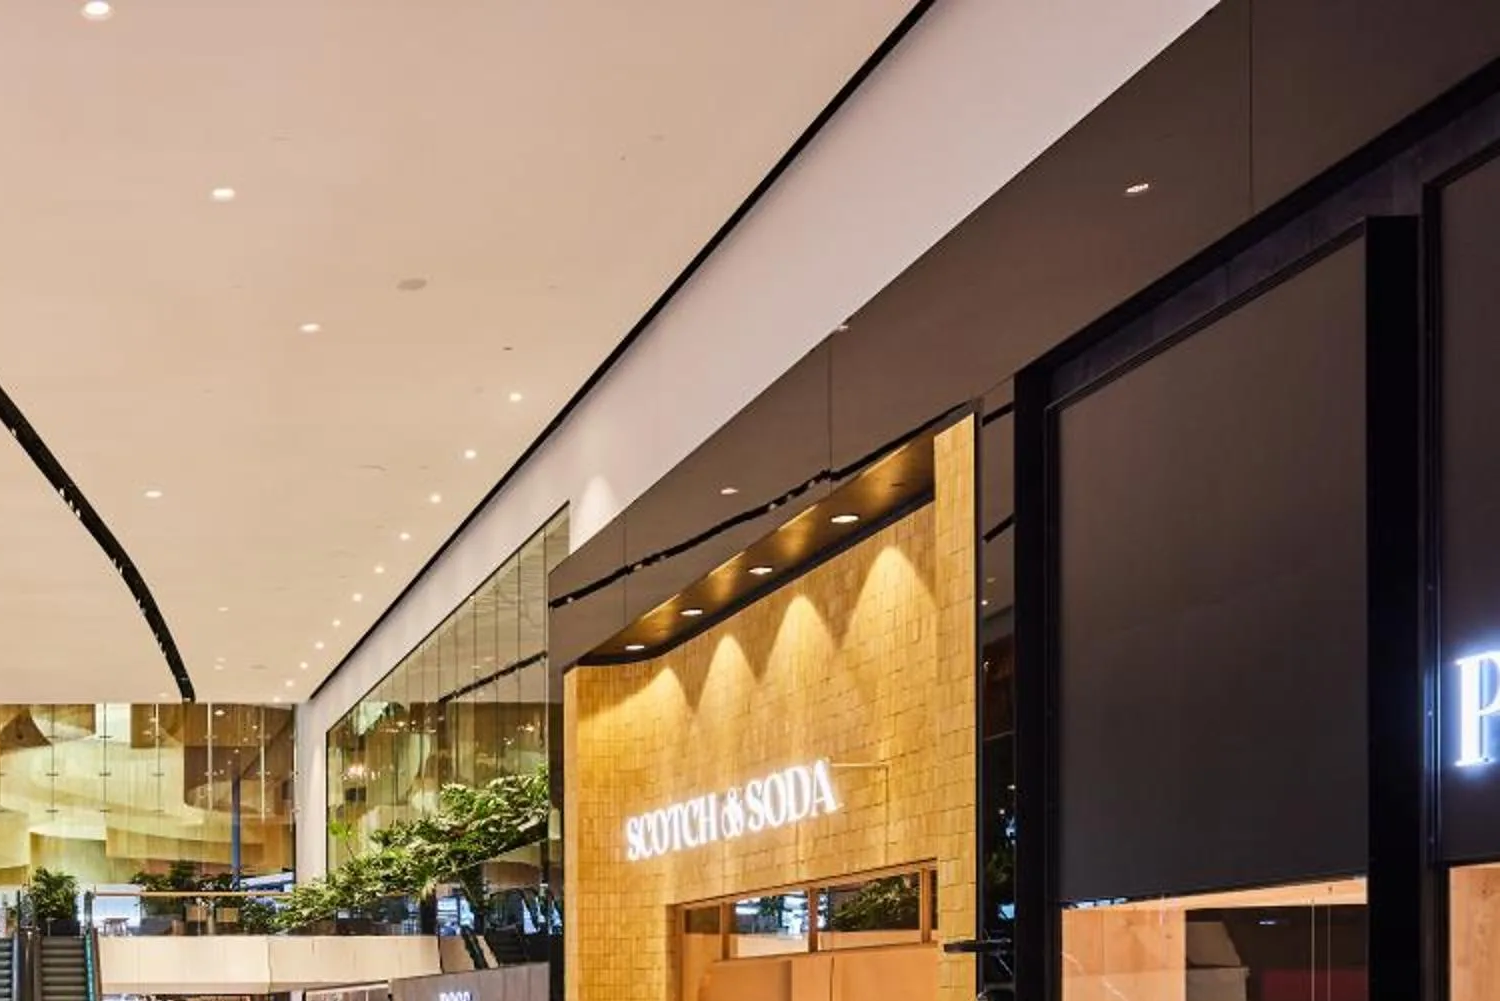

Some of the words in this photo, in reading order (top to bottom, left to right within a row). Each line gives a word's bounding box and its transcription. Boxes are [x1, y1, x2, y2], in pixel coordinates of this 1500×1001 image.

[626, 793, 718, 861] SCOTCH
[721, 787, 744, 839] &
[745, 758, 840, 833] SODA
